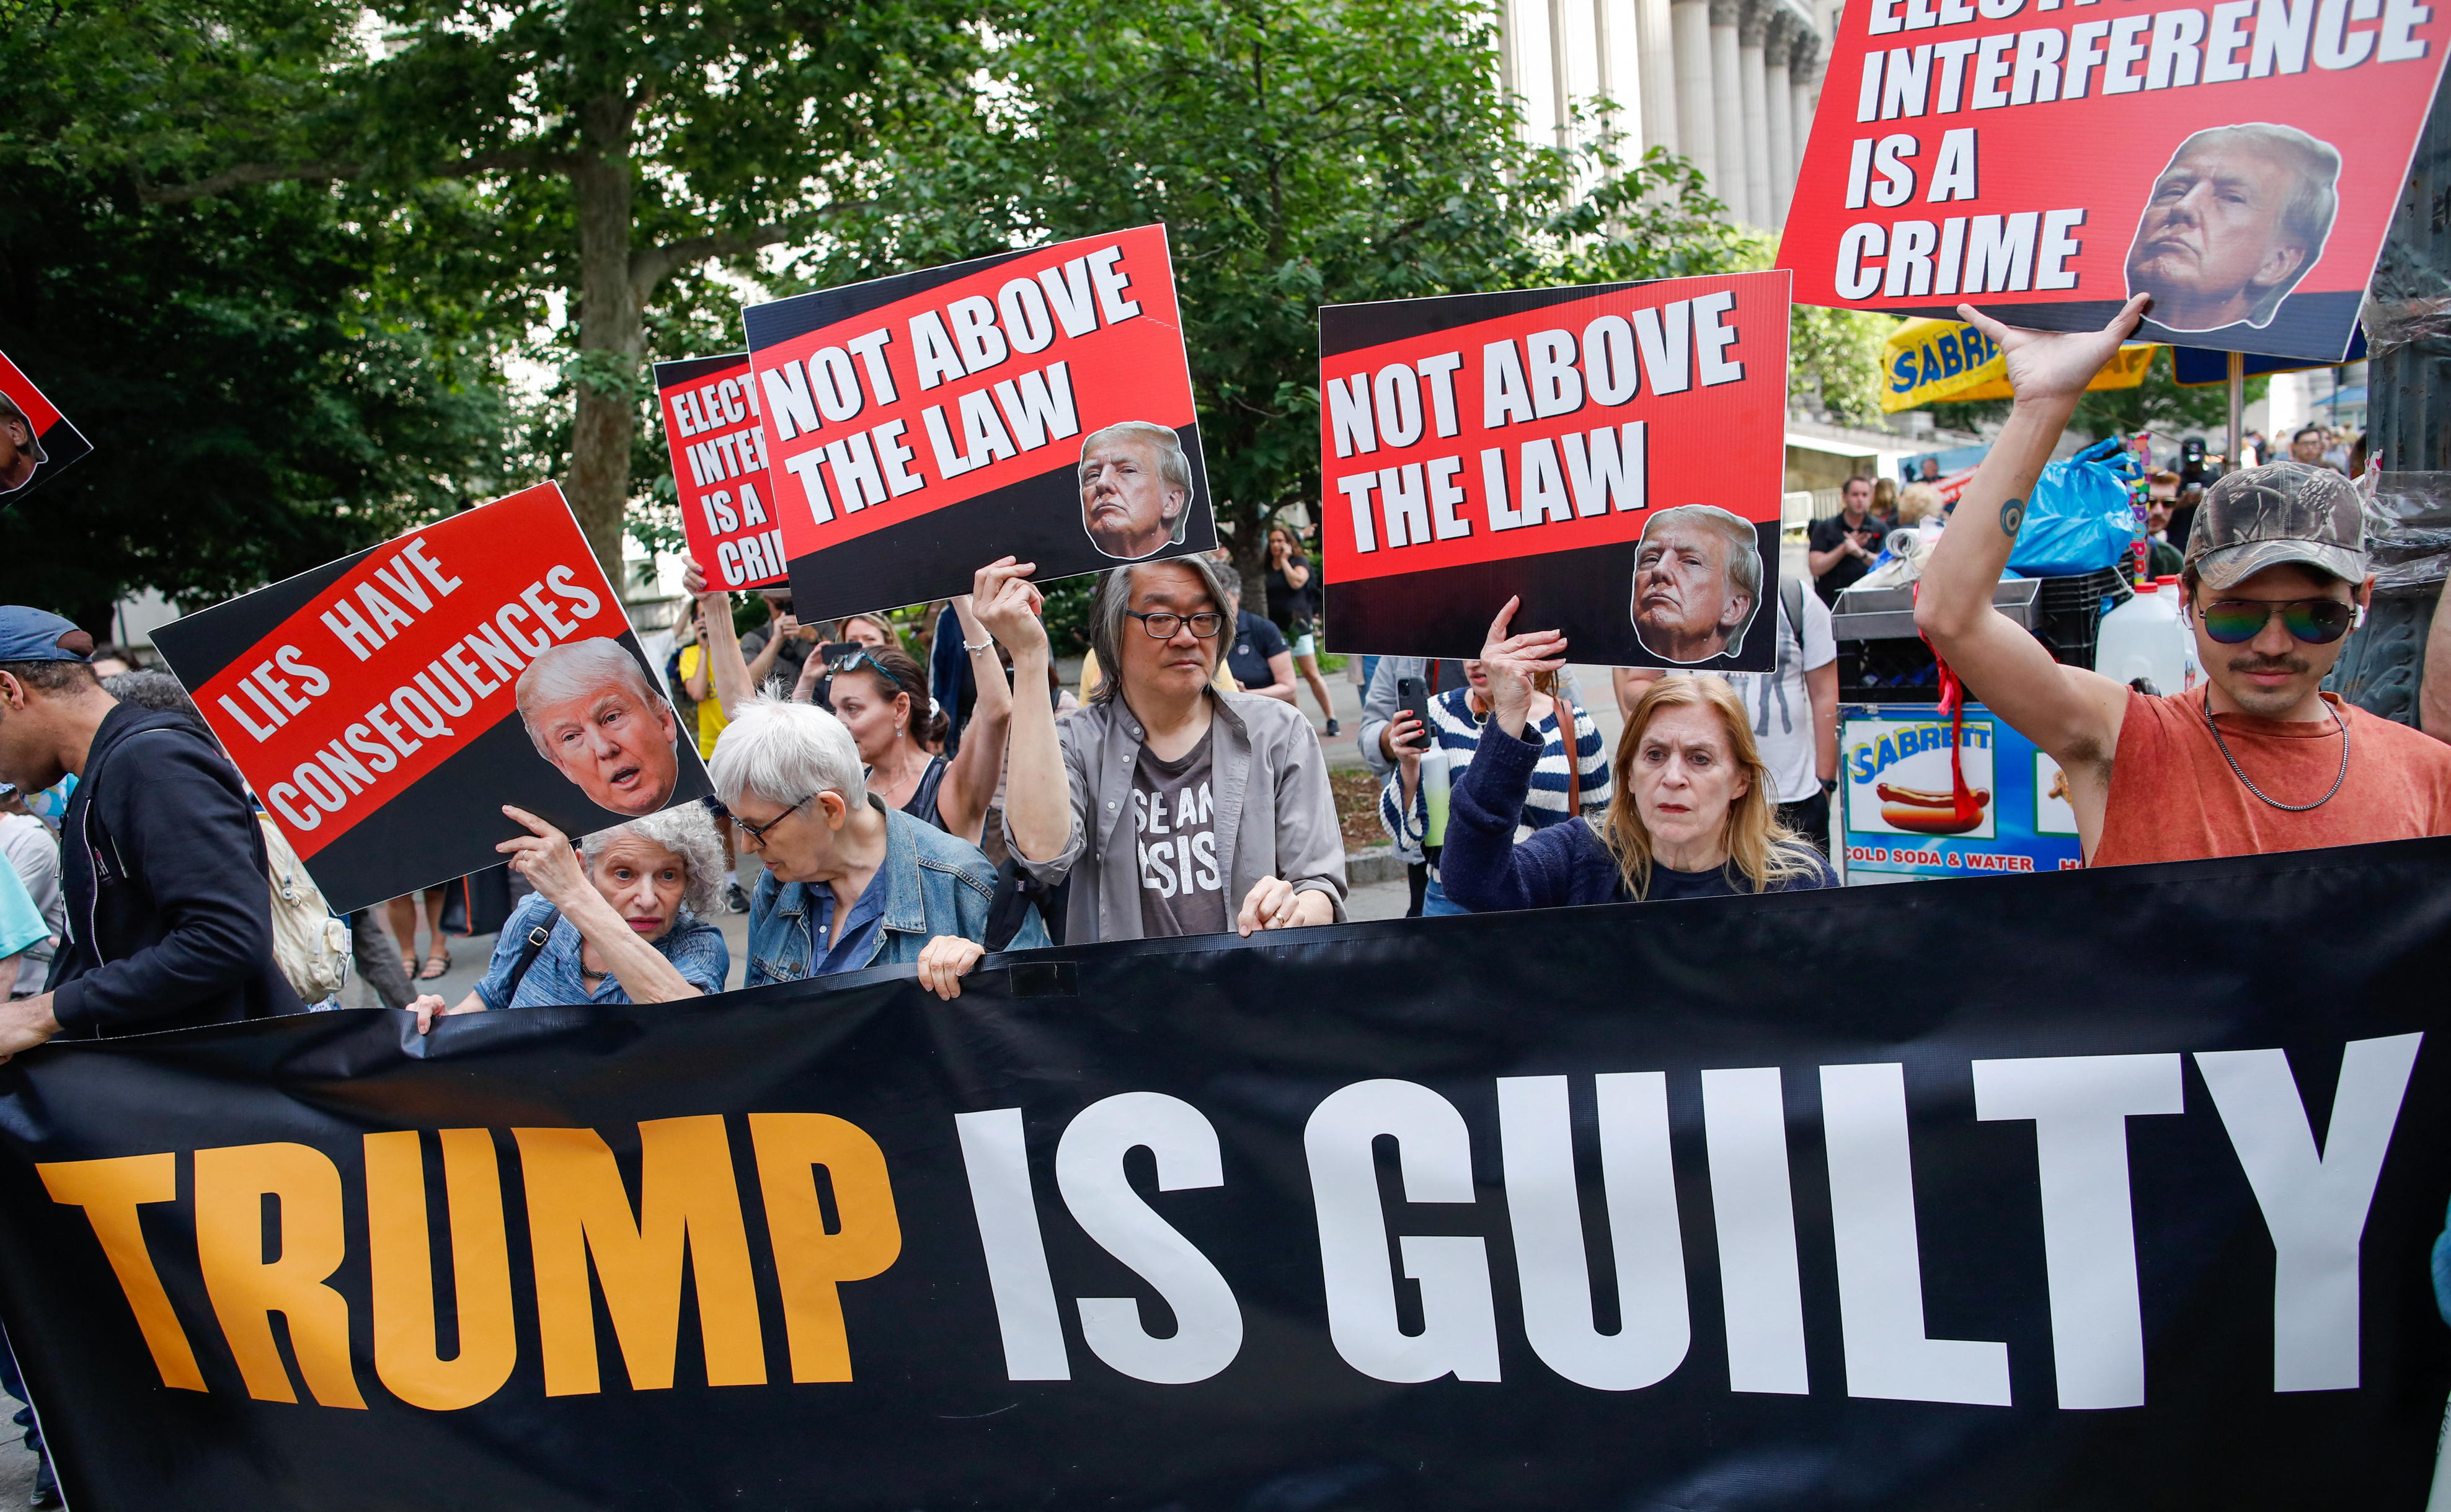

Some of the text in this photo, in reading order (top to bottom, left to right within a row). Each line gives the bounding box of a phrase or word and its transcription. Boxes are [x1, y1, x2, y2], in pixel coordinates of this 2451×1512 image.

[1856, 0, 2431, 123] INTERFERENCE
[1845, 127, 1976, 209] IS A
[1835, 208, 2085, 300] CRIME
[760, 244, 1140, 442] NOT ABOVE
[1327, 290, 1743, 458] NOT ABOVE
[700, 482, 768, 536] IS A
[784, 360, 1078, 525] THE LAW
[1337, 420, 1645, 553] THE LAW
[217, 536, 463, 743] LIES HAVE
[268, 565, 600, 831] CONSEQUENCES
[1848, 722, 1990, 784] SABRETT
[1893, 850, 1941, 865] SODA
[1947, 853, 1960, 867] &
[1966, 854, 2033, 871] WATER
[35, 1031, 2424, 1411] TRUMP IS GUILTY
